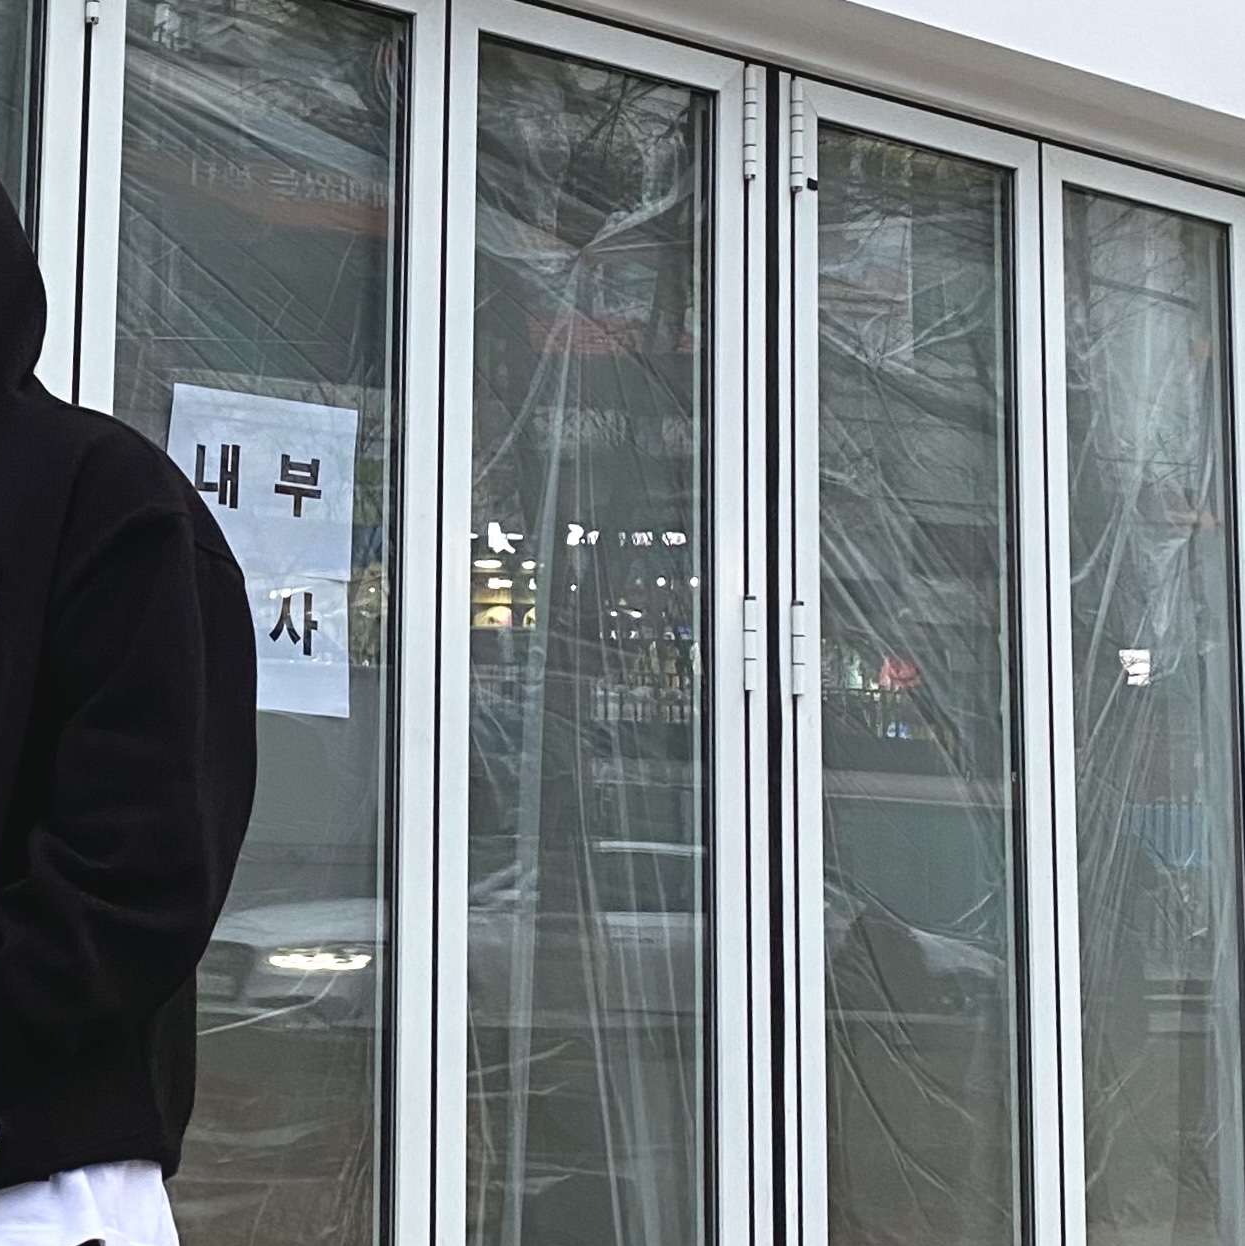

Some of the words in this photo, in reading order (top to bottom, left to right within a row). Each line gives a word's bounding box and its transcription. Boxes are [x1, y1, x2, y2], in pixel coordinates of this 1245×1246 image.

[194, 443, 241, 510] 내
[273, 453, 323, 518] 부
[268, 591, 319, 657] 사
